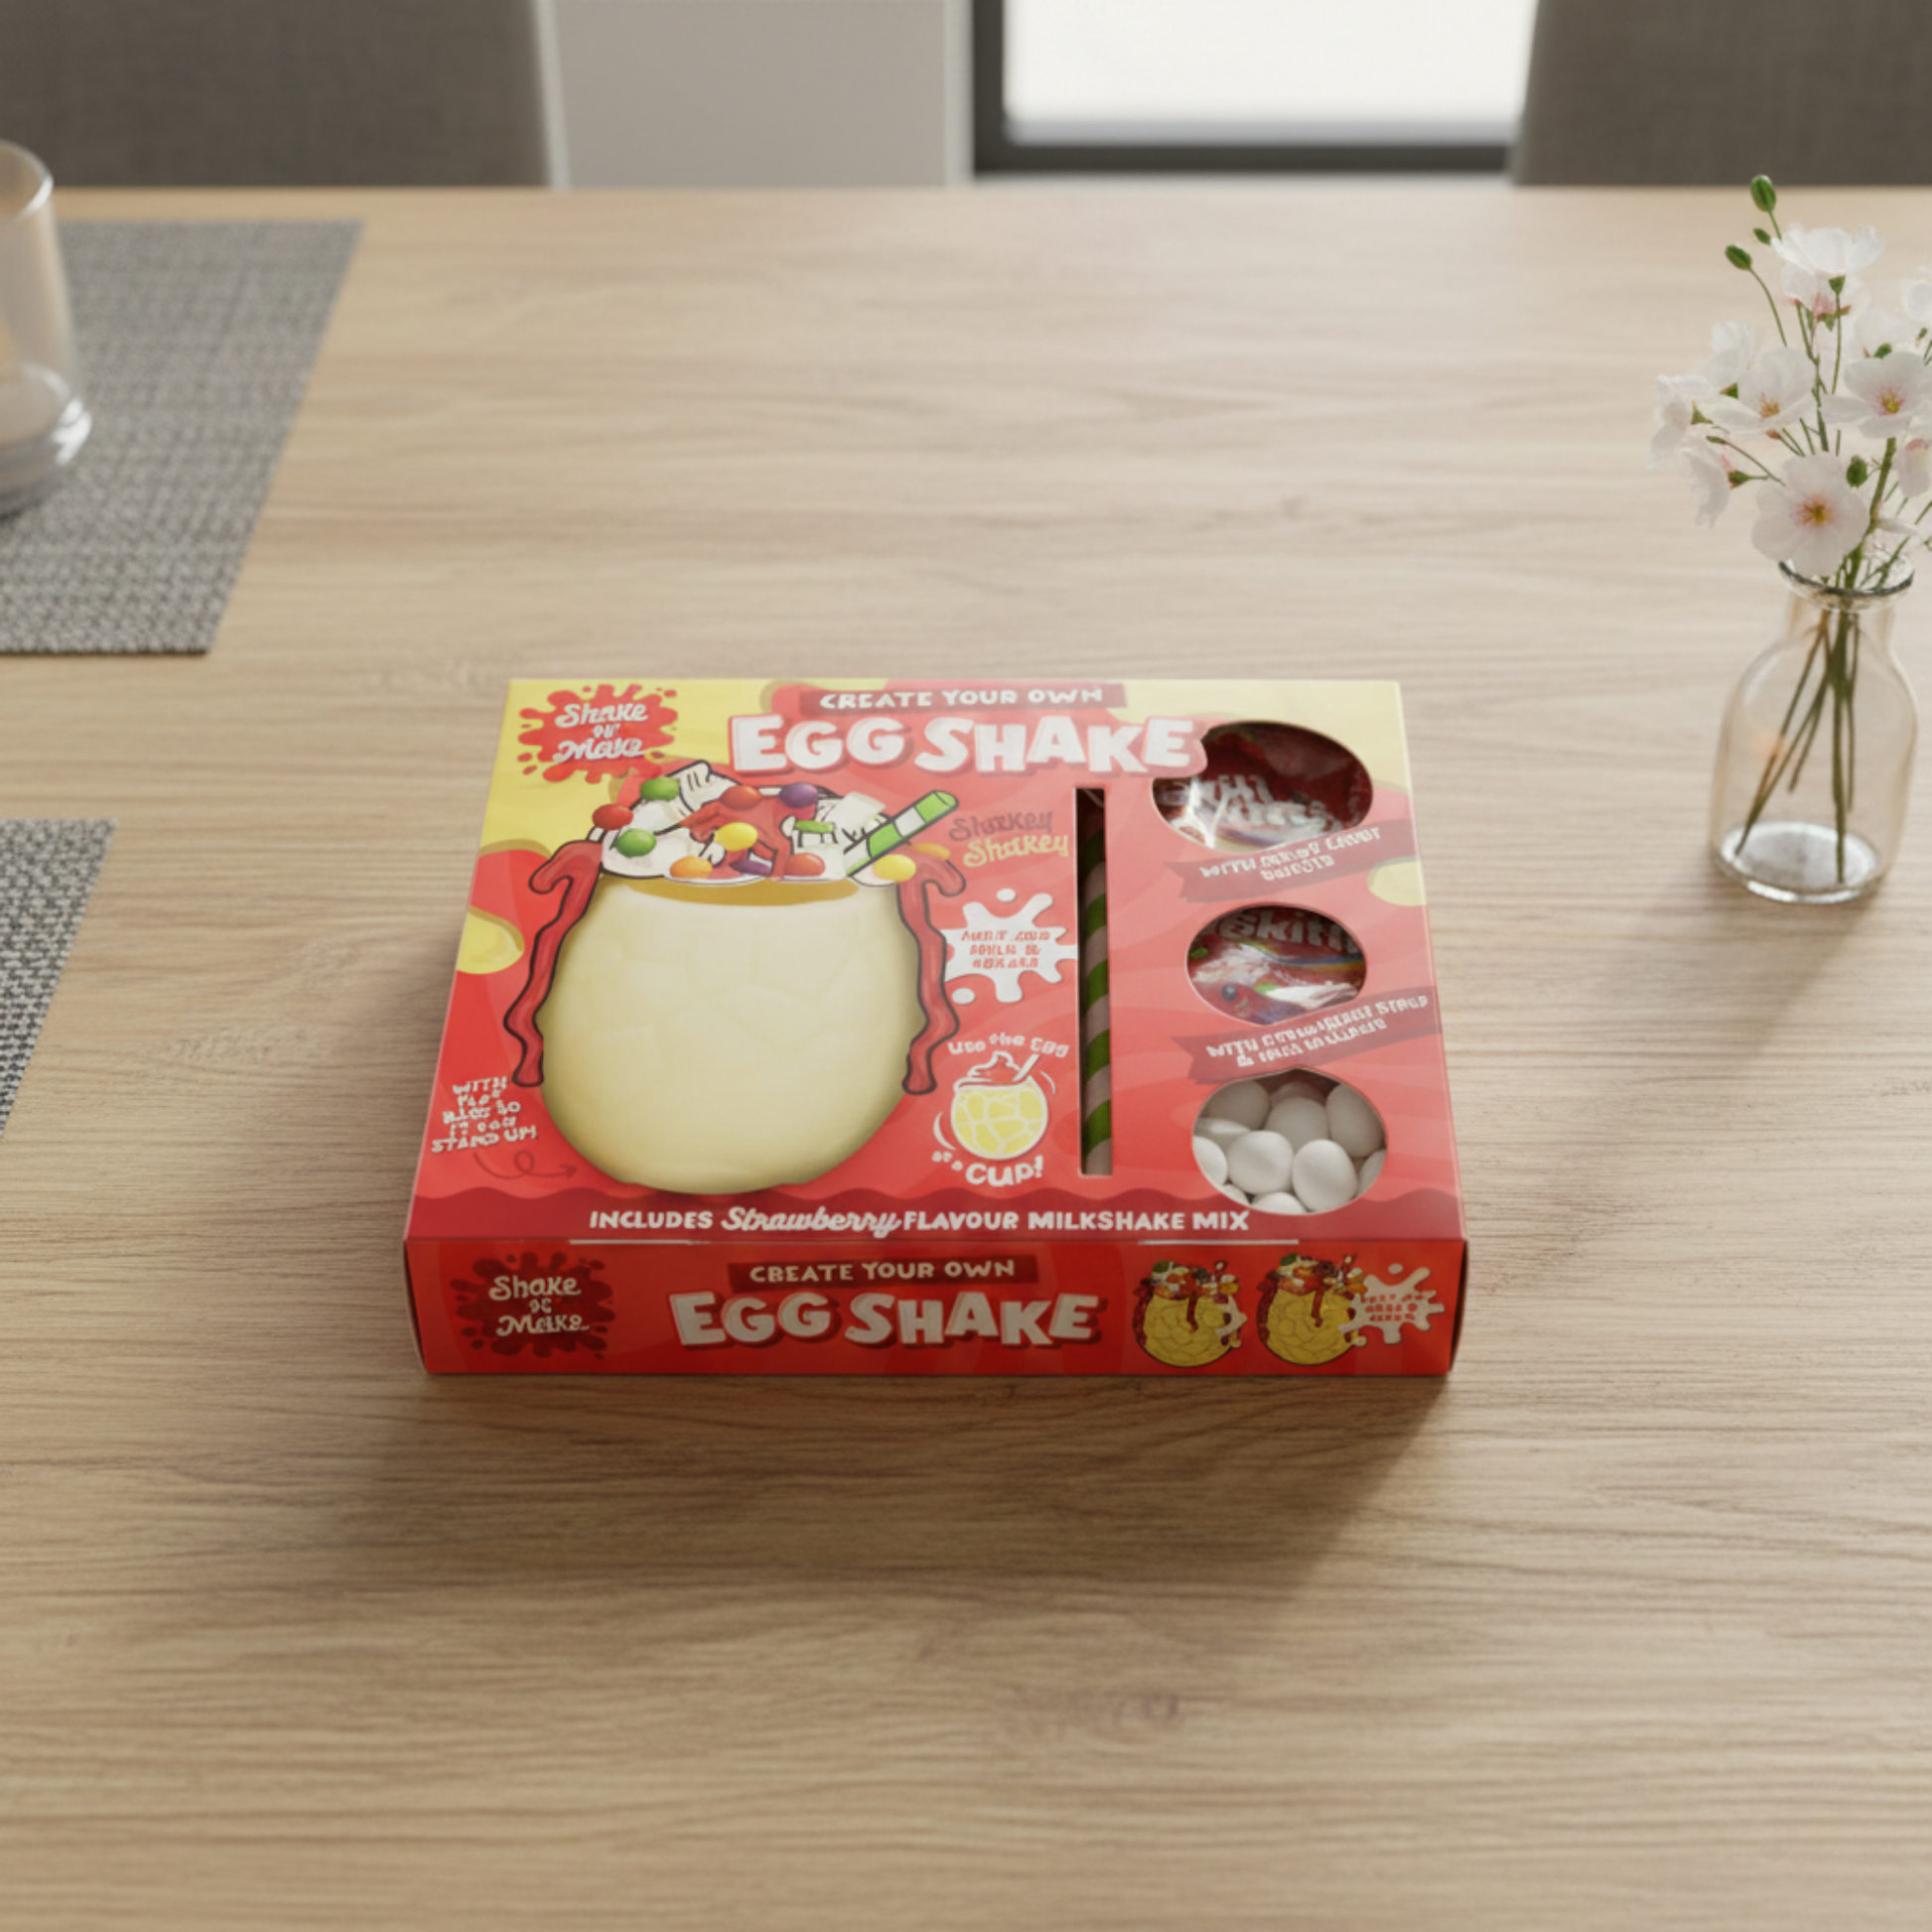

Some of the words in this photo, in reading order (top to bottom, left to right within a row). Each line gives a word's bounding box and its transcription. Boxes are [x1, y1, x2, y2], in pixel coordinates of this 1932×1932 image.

[819, 692, 932, 710] CREATE
[941, 689, 1017, 706] YOUR
[1027, 688, 1103, 704] OWN
[733, 715, 905, 772] EGG
[914, 716, 1194, 773] SHAKE
[589, 1210, 714, 1229] INCLUDES
[721, 1205, 901, 1239] Strawberry
[902, 1210, 1020, 1231] FLAVOUR
[1028, 1210, 1186, 1231] MILKSHAKE
[1192, 1210, 1251, 1231] MIX
[750, 1264, 854, 1283] CREATE
[861, 1261, 934, 1281] YOUR
[943, 1259, 1015, 1279] OWN
[487, 1275, 583, 1302] Shake
[669, 1292, 833, 1346] EGG
[844, 1292, 1099, 1345] SHAKE
